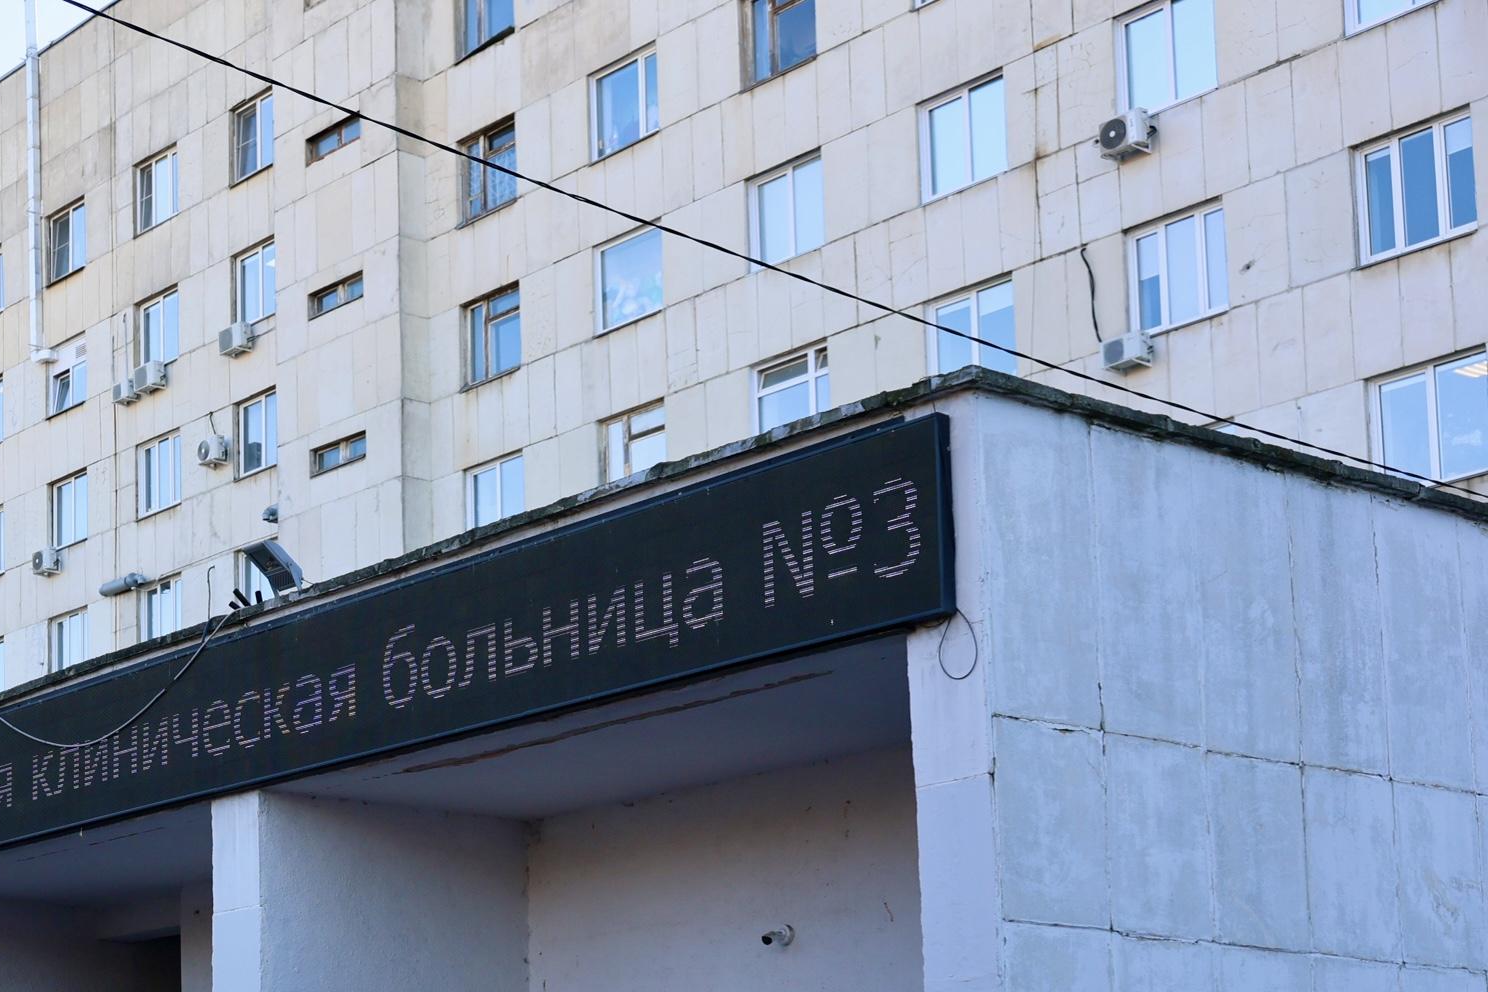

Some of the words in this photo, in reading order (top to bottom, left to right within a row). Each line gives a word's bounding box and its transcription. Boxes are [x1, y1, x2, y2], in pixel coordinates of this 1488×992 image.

[31, 663, 357, 802] клиническая
[382, 556, 724, 709] больница
[761, 477, 921, 608] №3
